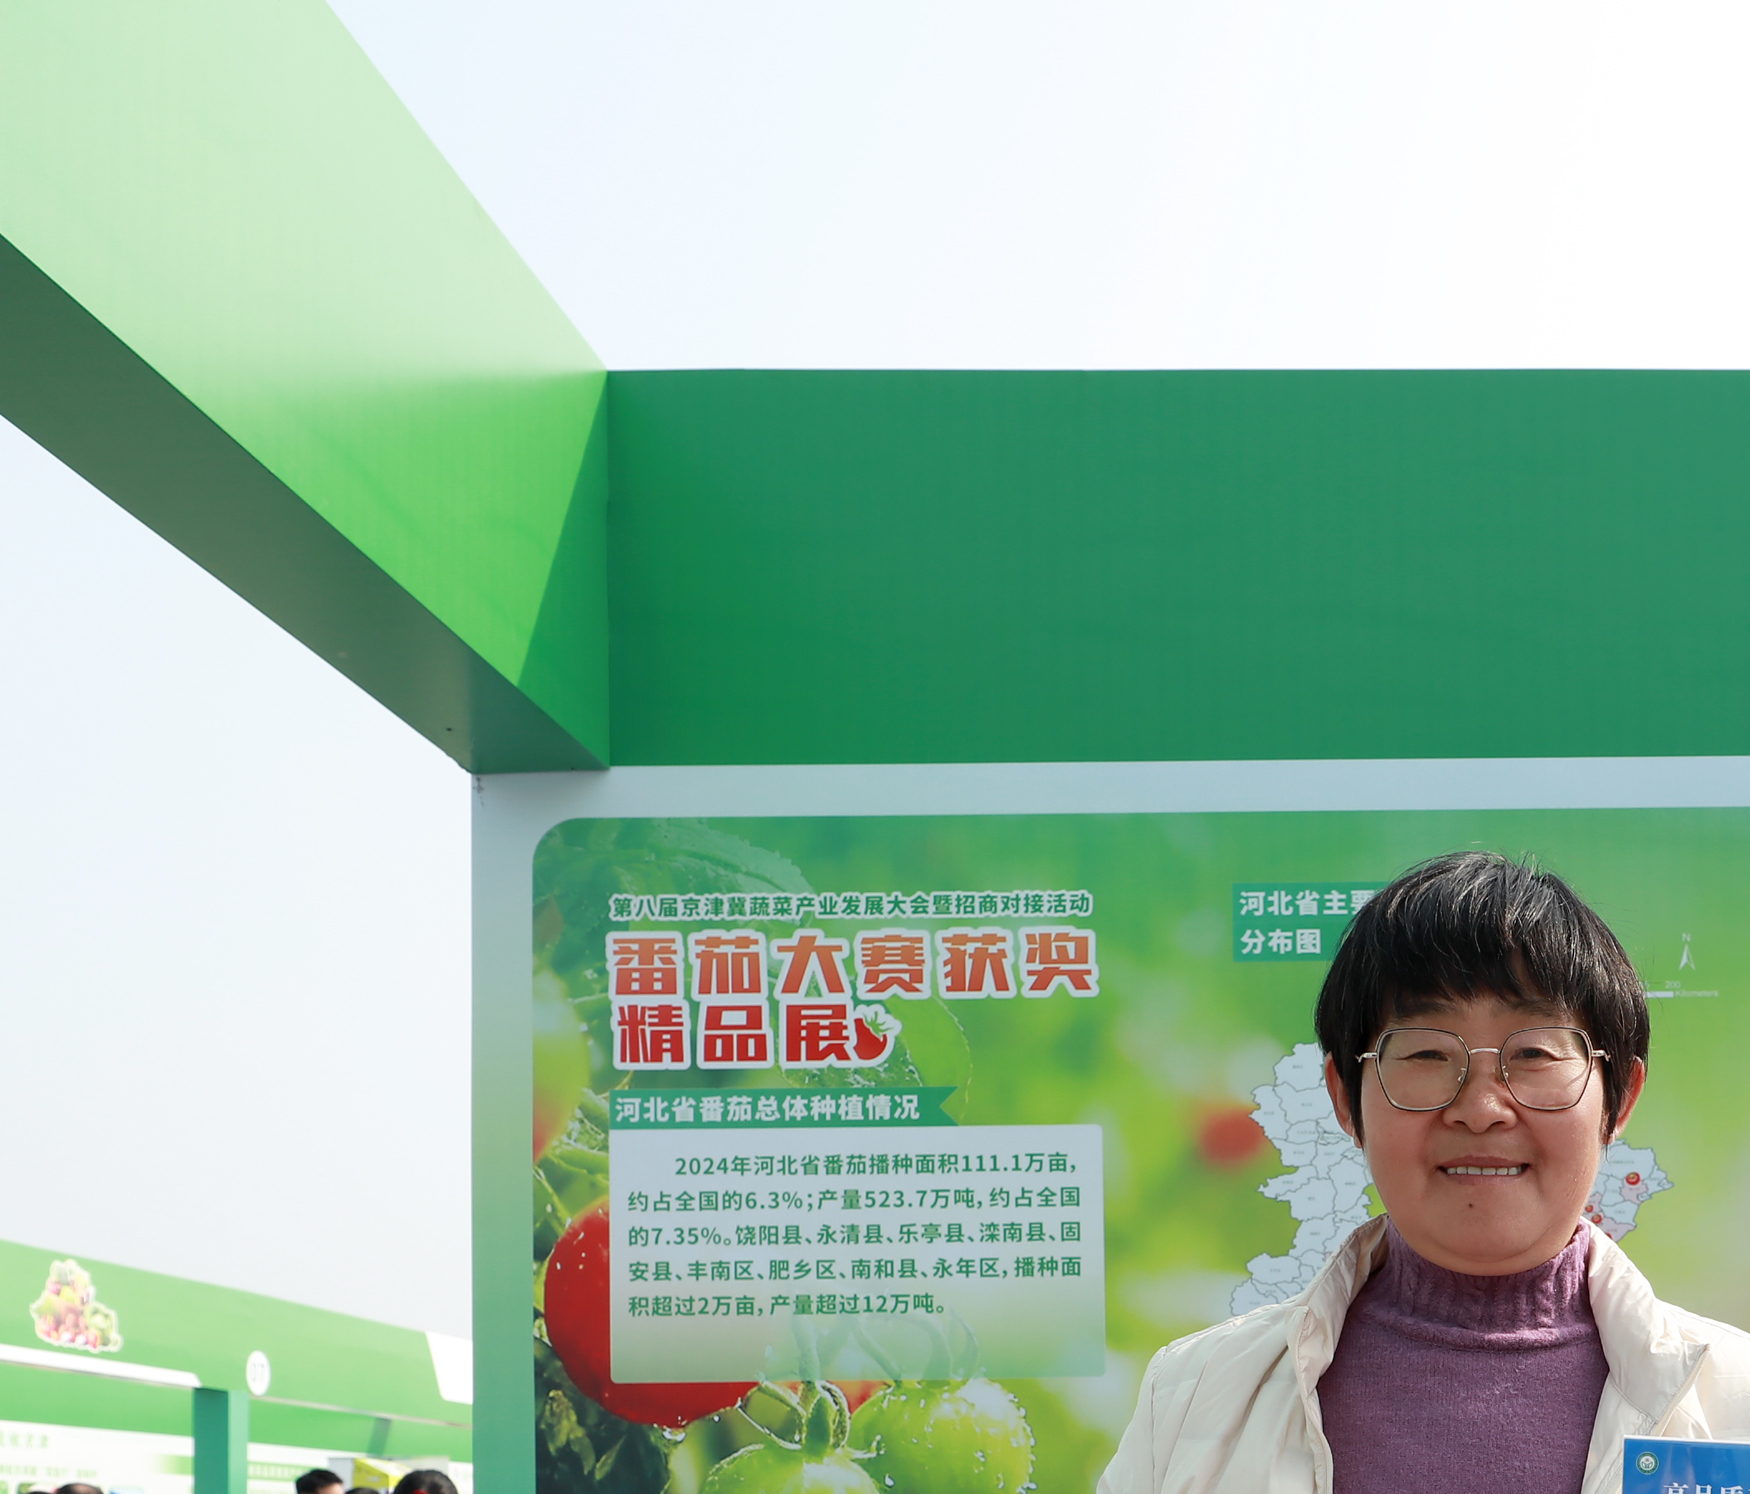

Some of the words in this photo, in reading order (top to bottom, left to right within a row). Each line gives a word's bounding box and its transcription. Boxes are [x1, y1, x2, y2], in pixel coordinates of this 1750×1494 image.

[612, 893, 1091, 919] 第八届京津冀蔬菜产业发展大会暨招商对接活动
[1240, 929, 1321, 954] 分布图
[1681, 933, 1691, 942] N
[611, 931, 1094, 996] 番茄大赛获奖
[617, 1003, 851, 1064] 精品展
[614, 1094, 921, 1123] 河北省番茄总体种植情况
[674, 1151, 1077, 1178] 2024年河北省番茄播种面积111.1万亩，
[628, 1256, 1082, 1283] 安县、丰南区、肥乡区、南和县、永年区，播种面
[628, 1293, 946, 1318] 积超过2万亩，产量超过12万吨。
